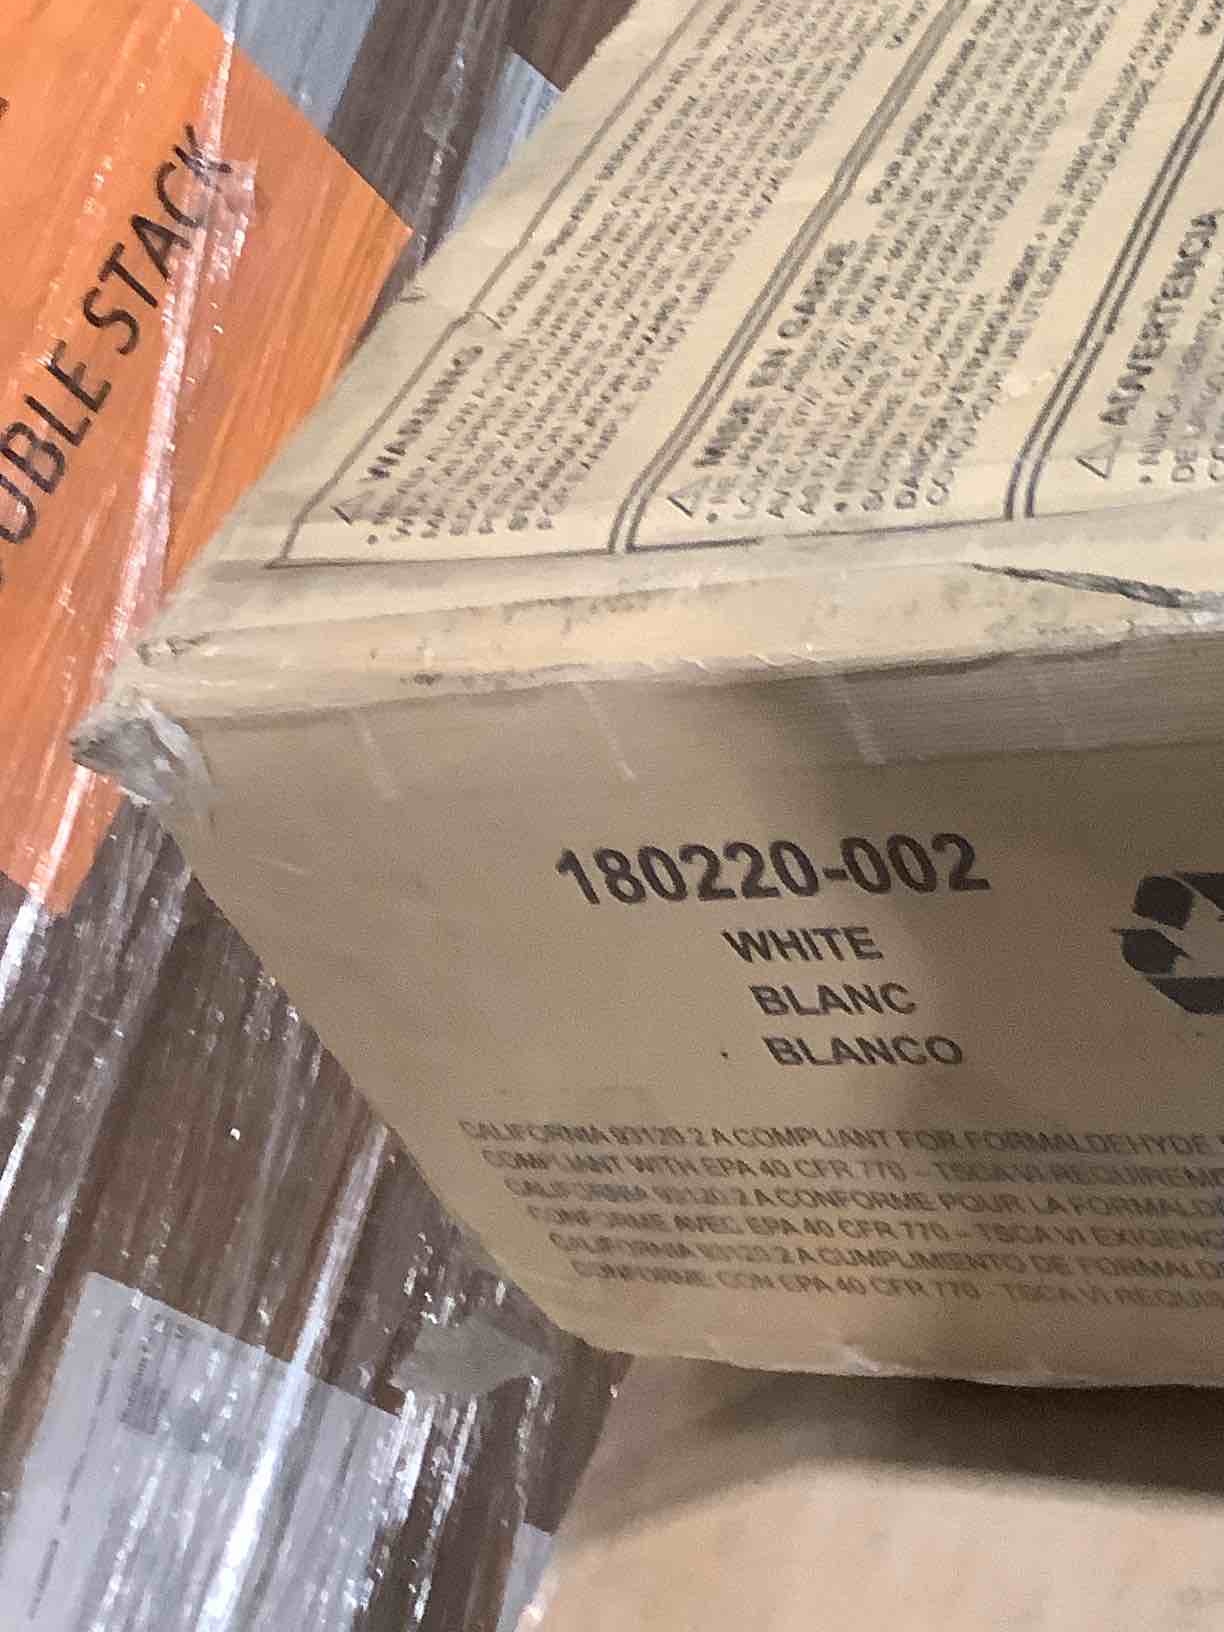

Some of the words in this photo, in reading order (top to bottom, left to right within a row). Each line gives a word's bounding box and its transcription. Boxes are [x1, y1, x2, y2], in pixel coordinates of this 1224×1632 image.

[80, 123, 233, 356] STACK
[1096, 215, 1223, 422] ADVERTENCIA
[554, 832, 992, 906] 180220-002
[720, 925, 886, 966] WHITE
[748, 981, 918, 1017] BLANC
[762, 1034, 966, 1067] BLANCO
[456, 1118, 612, 1146] CALIFORNIA
[729, 1126, 893, 1146] COMPLIANT
[894, 1128, 962, 1152] FOR
[961, 1130, 1215, 1156] FORMALDEHYDE
[624, 1155, 699, 1176] WITH
[698, 1156, 758, 1177] EPA
[756, 1158, 793, 1178] 40
[791, 1158, 856, 1180] CFR
[774, 1186, 941, 1214] CONFORME
[936, 1191, 1027, 1215] POUR
[1026, 1195, 1070, 1215] LA
[743, 1215, 801, 1237] EPA
[798, 1217, 837, 1238] 40
[835, 1217, 899, 1240] CFR
[897, 1220, 951, 1241] 770
[814, 1244, 1028, 1275] CUMPLIMIENTO
[1028, 1254, 1074, 1276] DE
[776, 1273, 835, 1294] EPA
[832, 1274, 869, 1295] 40
[867, 1275, 929, 1297] CFR
